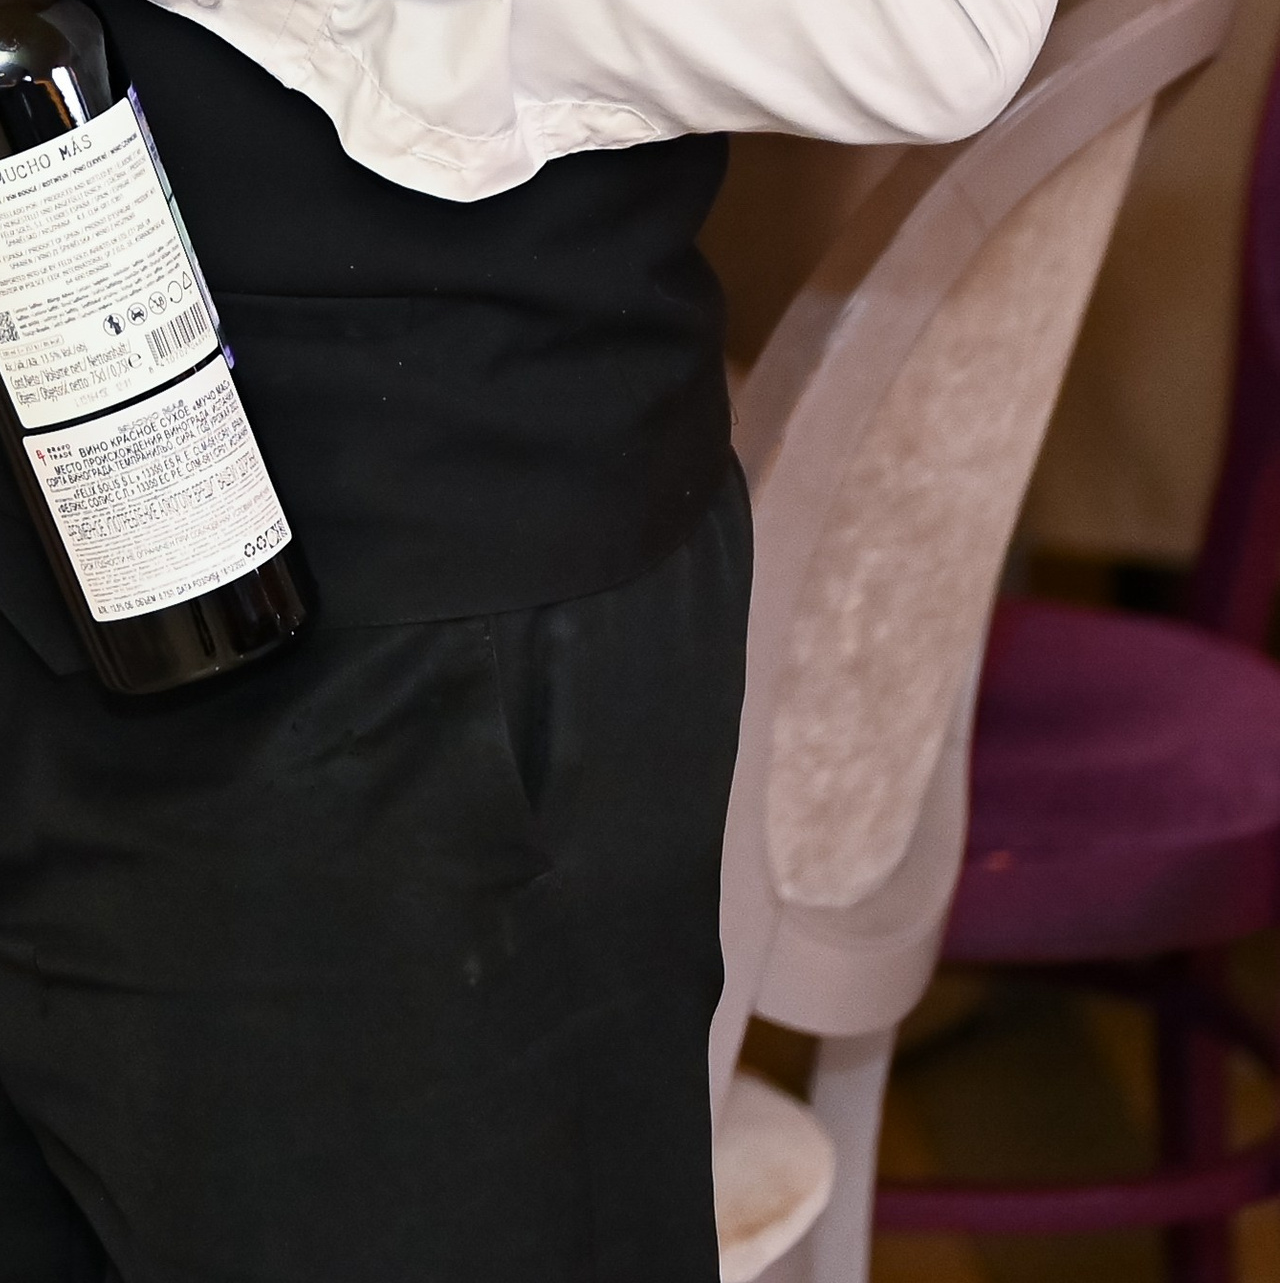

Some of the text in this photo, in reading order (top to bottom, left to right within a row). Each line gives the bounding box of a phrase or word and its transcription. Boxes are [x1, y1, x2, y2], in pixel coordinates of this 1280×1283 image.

[57, 131, 93, 161] MÁS
[78, 439, 109, 459] ВИНО
[109, 420, 158, 448] КРАСНОЕ
[159, 404, 191, 429] СУХОЕ
[53, 461, 83, 476] МЕСТО
[82, 432, 163, 470] ПРОИСХОЖДЕНИЯ
